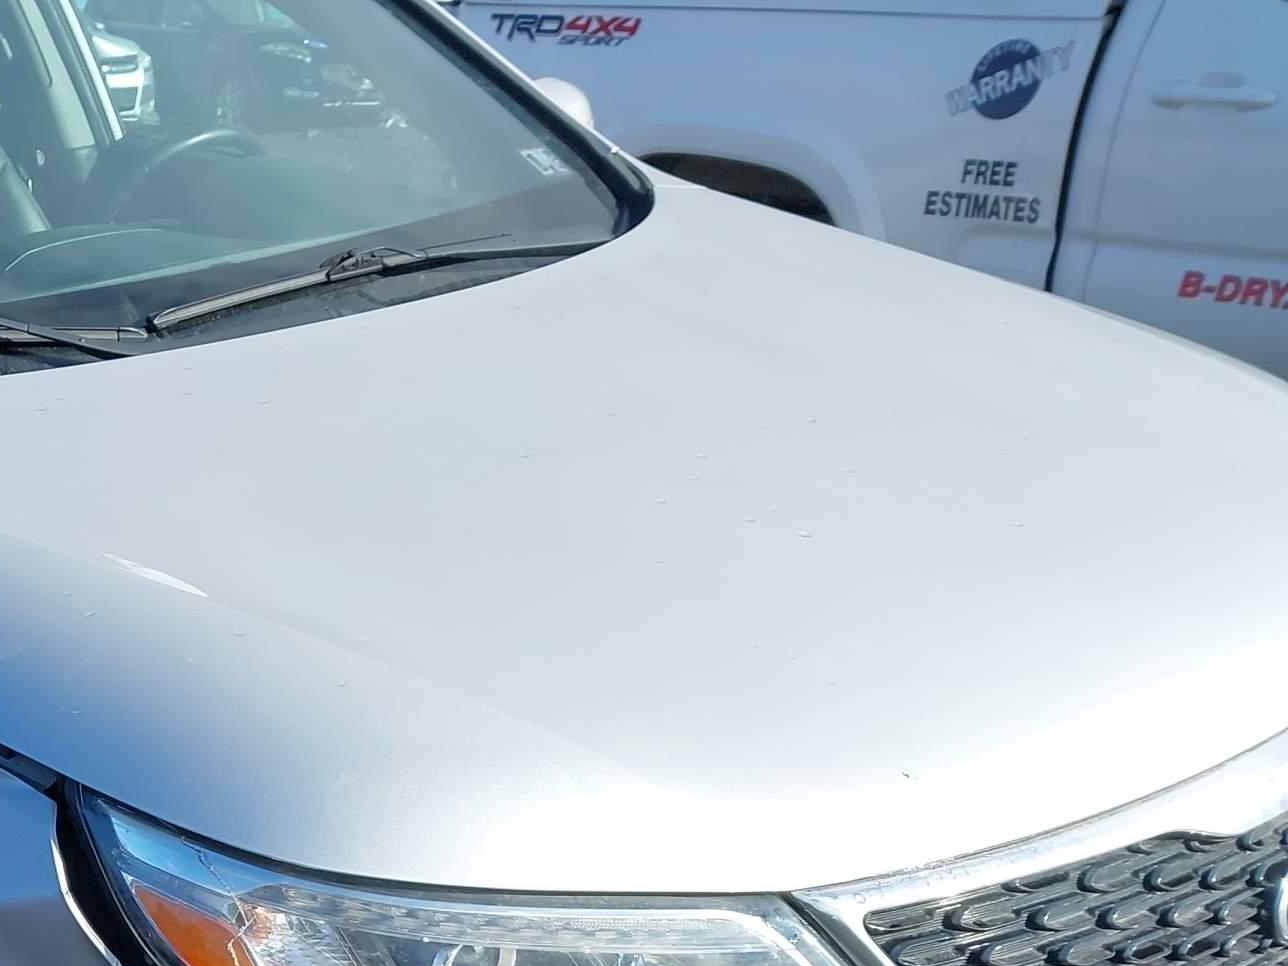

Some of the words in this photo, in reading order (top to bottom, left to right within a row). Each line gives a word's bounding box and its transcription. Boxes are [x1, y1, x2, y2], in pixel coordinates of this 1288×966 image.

[944, 40, 1076, 117] WARRANTY
[961, 158, 1018, 187] FREE
[924, 190, 1041, 224] ESTIMATES
